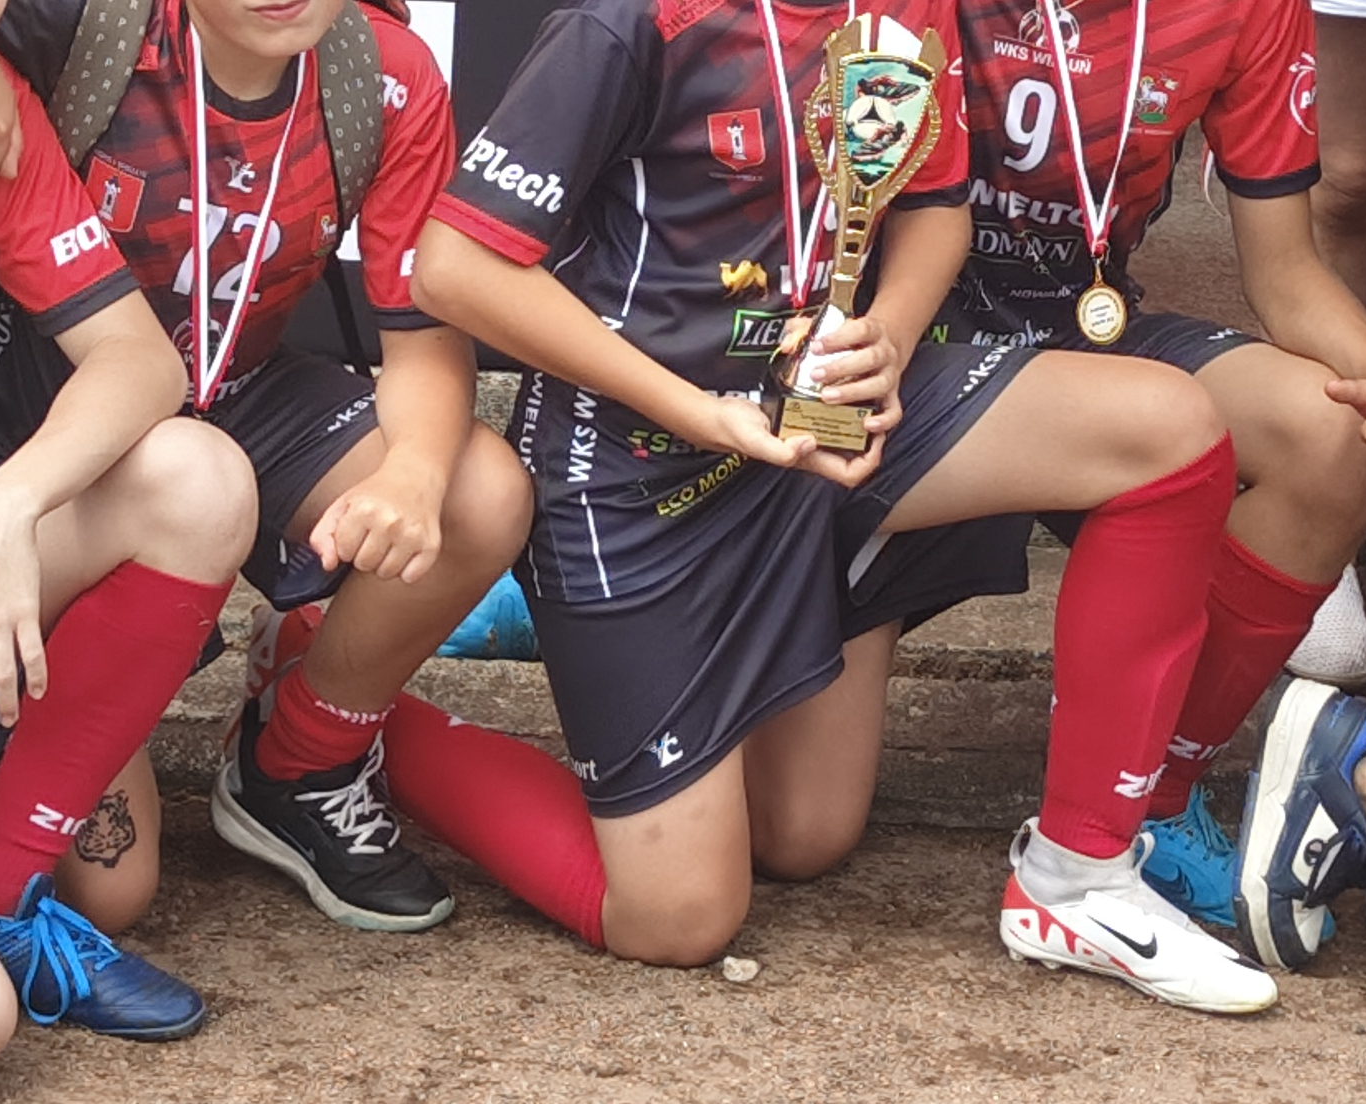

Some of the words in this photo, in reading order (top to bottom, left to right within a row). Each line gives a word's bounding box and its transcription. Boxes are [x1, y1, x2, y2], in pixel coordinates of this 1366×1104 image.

[1002, 76, 1059, 174] 9
[462, 135, 567, 214] Plech
[172, 197, 282, 304] 72
[567, 423, 599, 483] WKS
